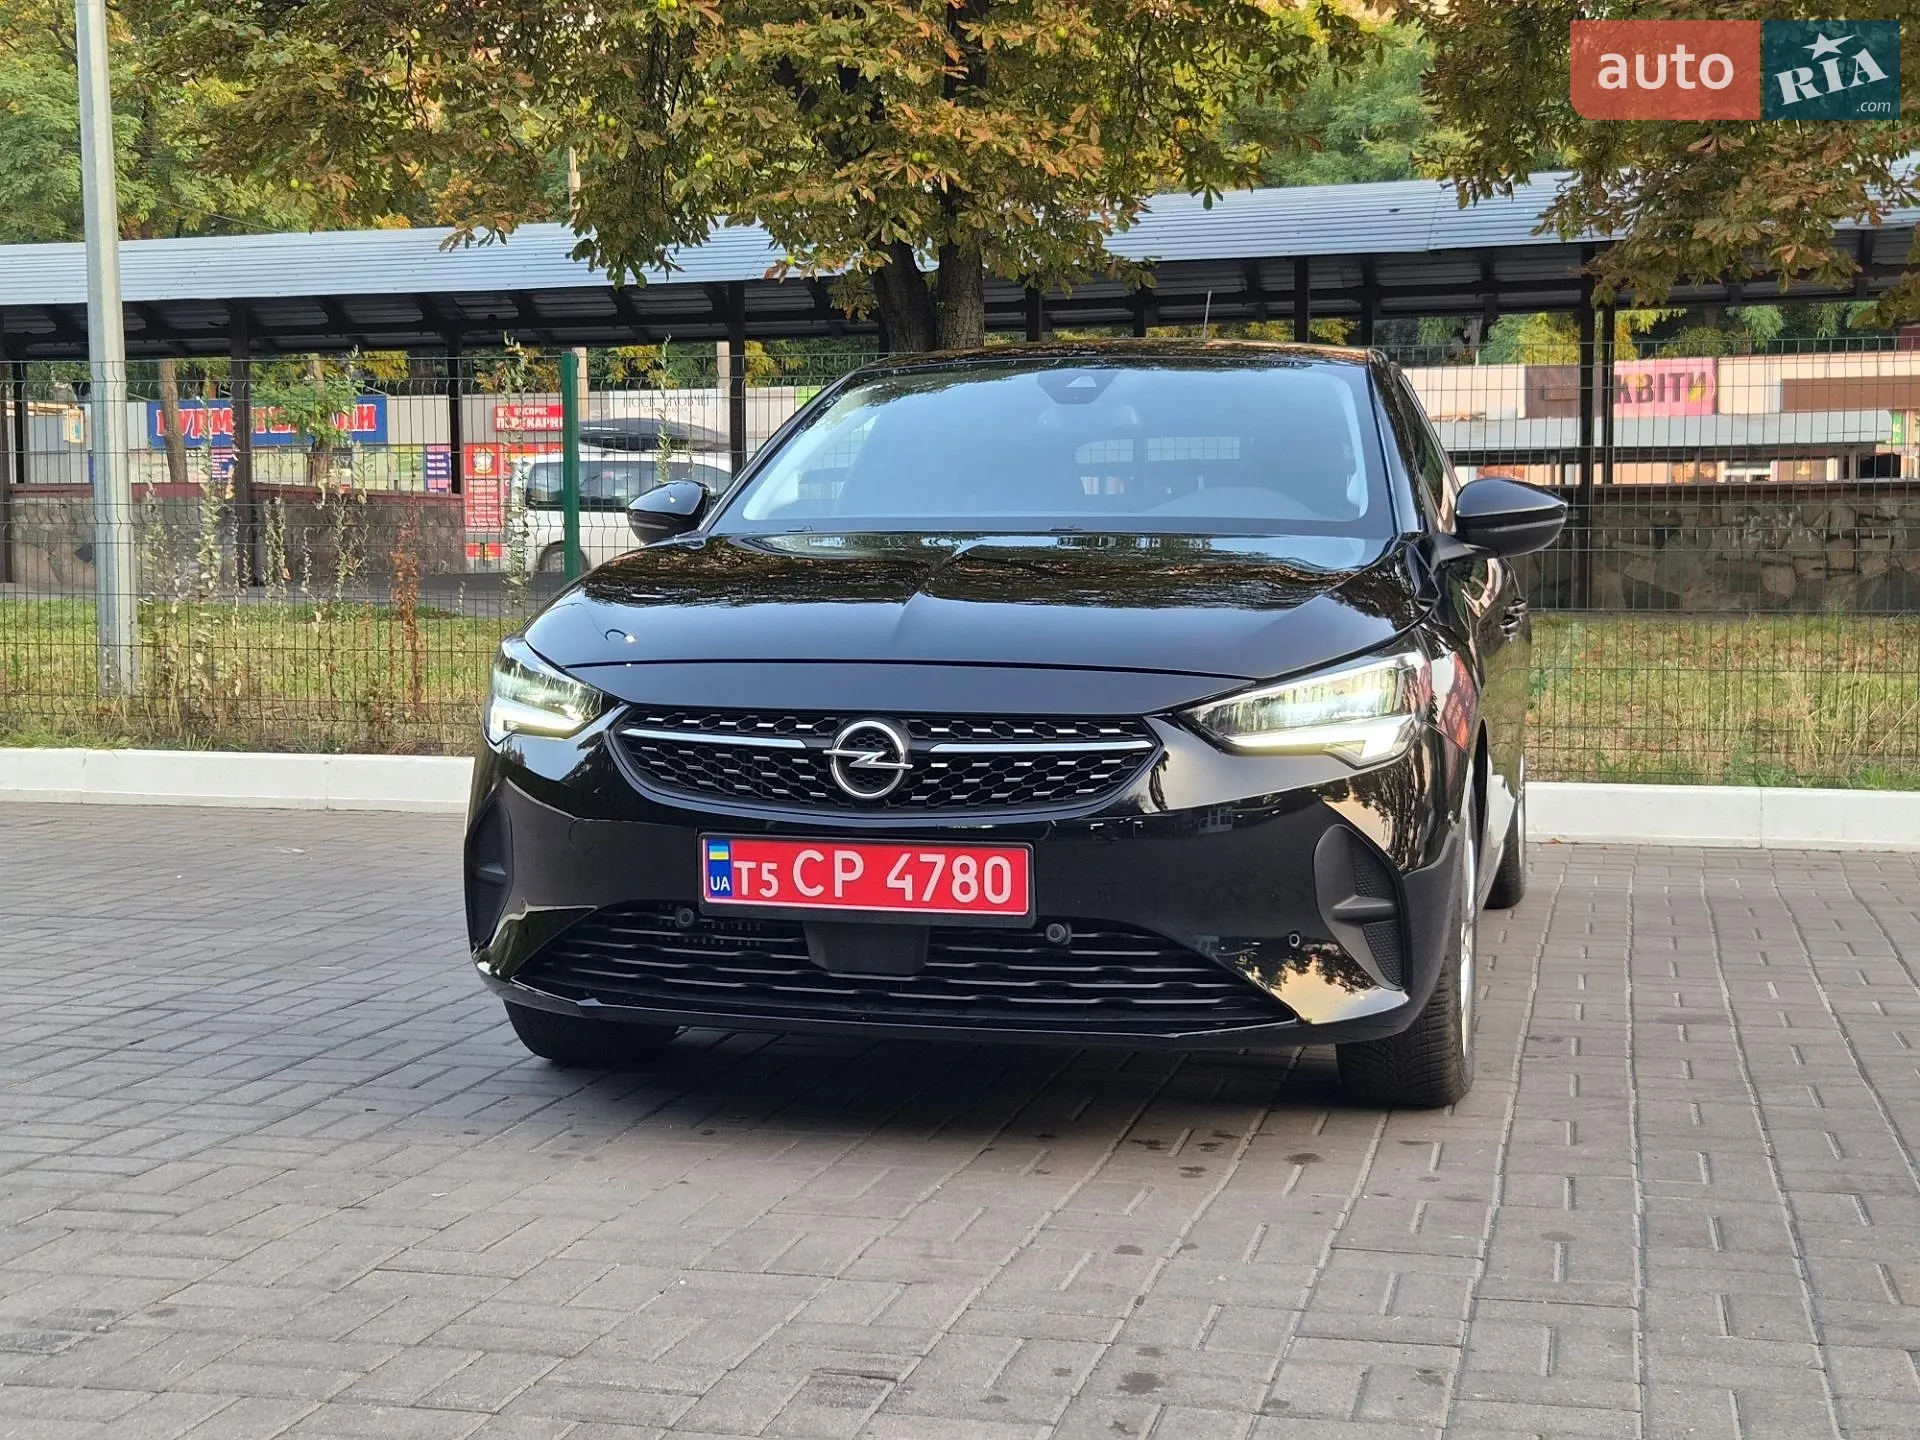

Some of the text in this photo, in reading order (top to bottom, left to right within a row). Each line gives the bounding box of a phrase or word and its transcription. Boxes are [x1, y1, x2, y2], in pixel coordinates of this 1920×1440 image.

[1613, 371, 1708, 404] КВІТИ
[156, 403, 377, 438] УДМТЕЛИ
[709, 875, 731, 892] UA
[733, 849, 1012, 905] T5 CP 4780
